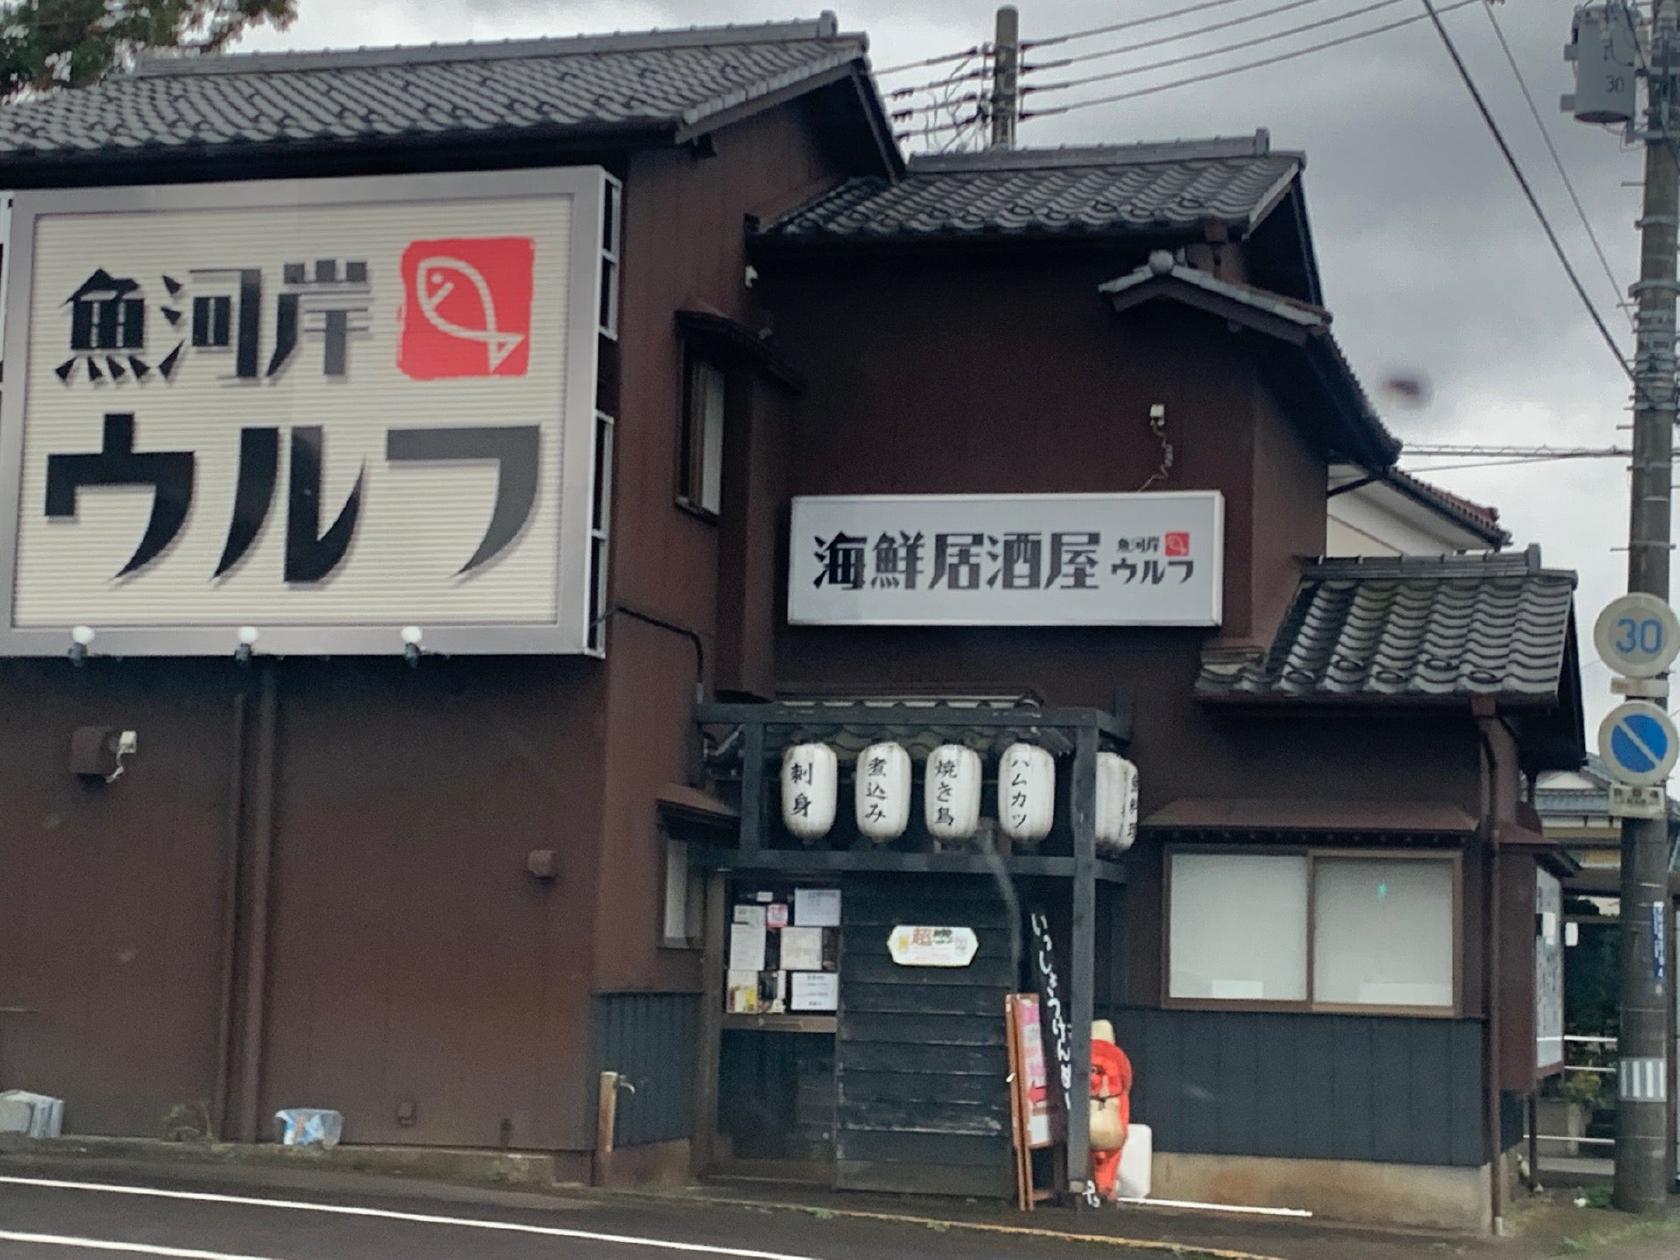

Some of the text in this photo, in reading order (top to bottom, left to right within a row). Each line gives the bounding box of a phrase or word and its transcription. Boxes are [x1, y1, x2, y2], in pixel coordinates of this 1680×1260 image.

[55, 259, 374, 383] 魚河岸
[45, 412, 541, 583] ウルフ
[812, 531, 1101, 590] 海鮮居酒屋
[1111, 557, 1194, 585] ウルフ
[1615, 617, 1663, 655] 30
[791, 761, 813, 818] 刺身
[865, 757, 887, 823] 煮込み
[935, 759, 958, 827] 焼き鳥
[1009, 759, 1030, 829] ハムカツ
